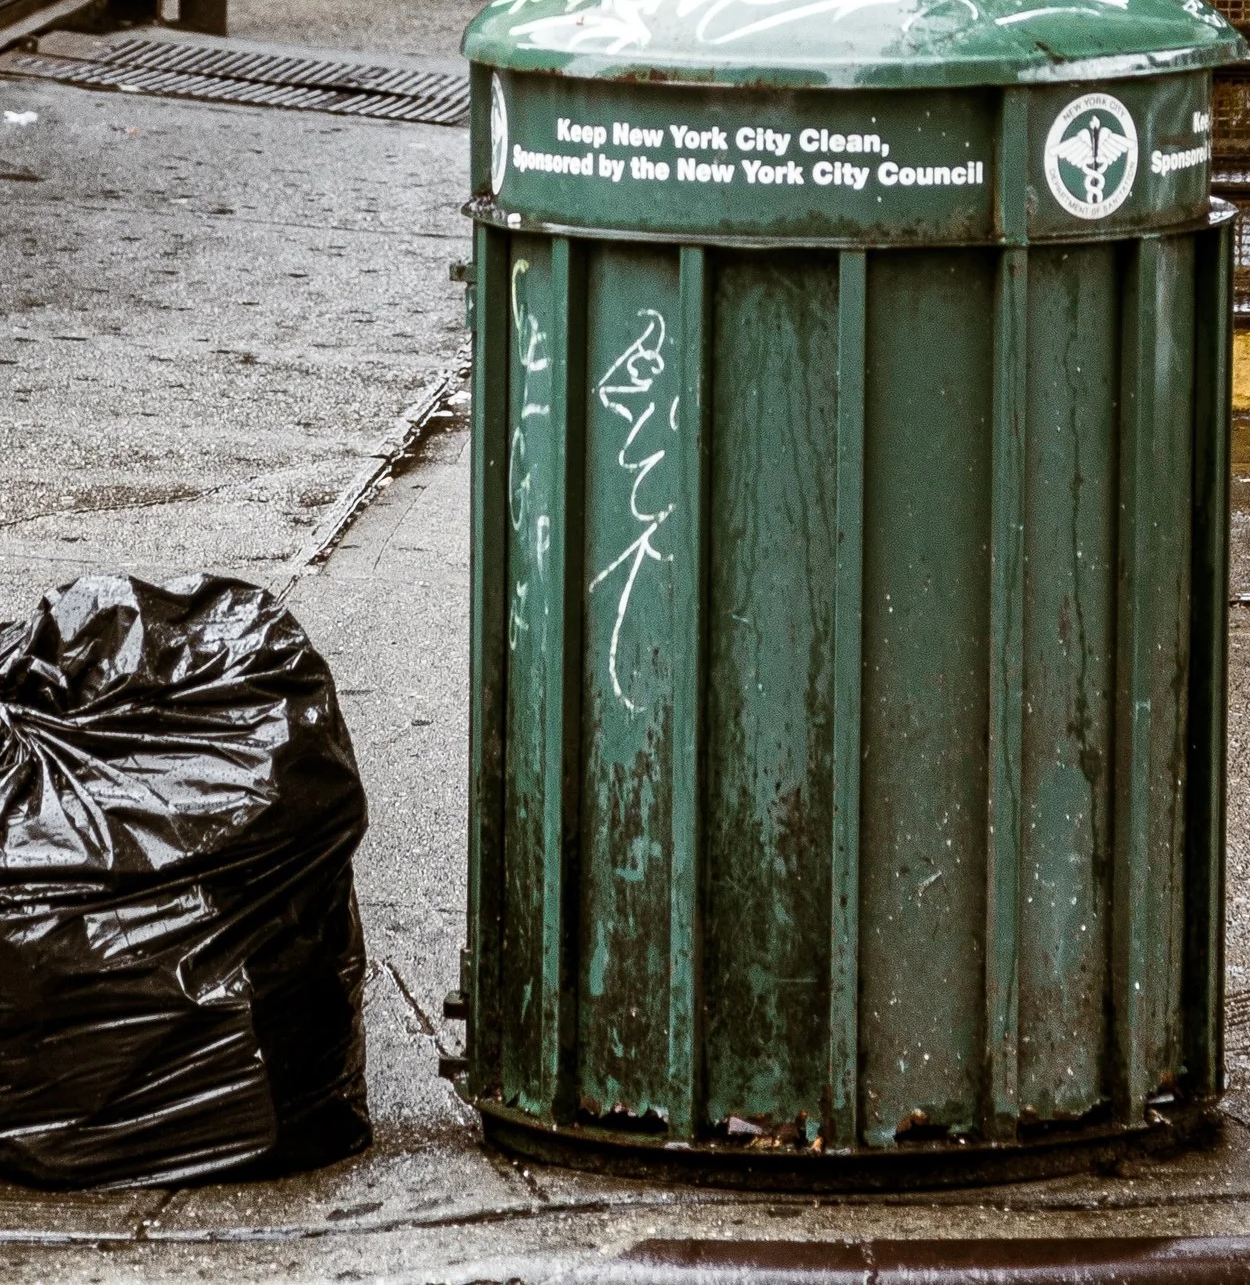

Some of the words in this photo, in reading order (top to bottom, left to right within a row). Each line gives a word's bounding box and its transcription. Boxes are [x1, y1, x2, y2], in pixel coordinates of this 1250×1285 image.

[1063, 102, 1083, 122] NEW
[1084, 97, 1107, 108] YORK
[1109, 102, 1126, 118] CITY
[557, 118, 607, 149] Keep
[613, 122, 665, 148] New
[670, 125, 729, 150] York
[736, 127, 791, 156] City
[799, 129, 889, 157] Clean,
[513, 144, 597, 177] Sponsored
[599, 154, 625, 183] by
[630, 156, 670, 182] the
[677, 158, 735, 183] New
[741, 160, 804, 184] York
[812, 161, 870, 190] City
[878, 161, 983, 185] Council
[1151, 141, 1208, 177] Sponsored
[1048, 166, 1090, 217] DEPARTMENT
[1091, 205, 1100, 216] OF
[1102, 159, 1136, 216] SANITATION
